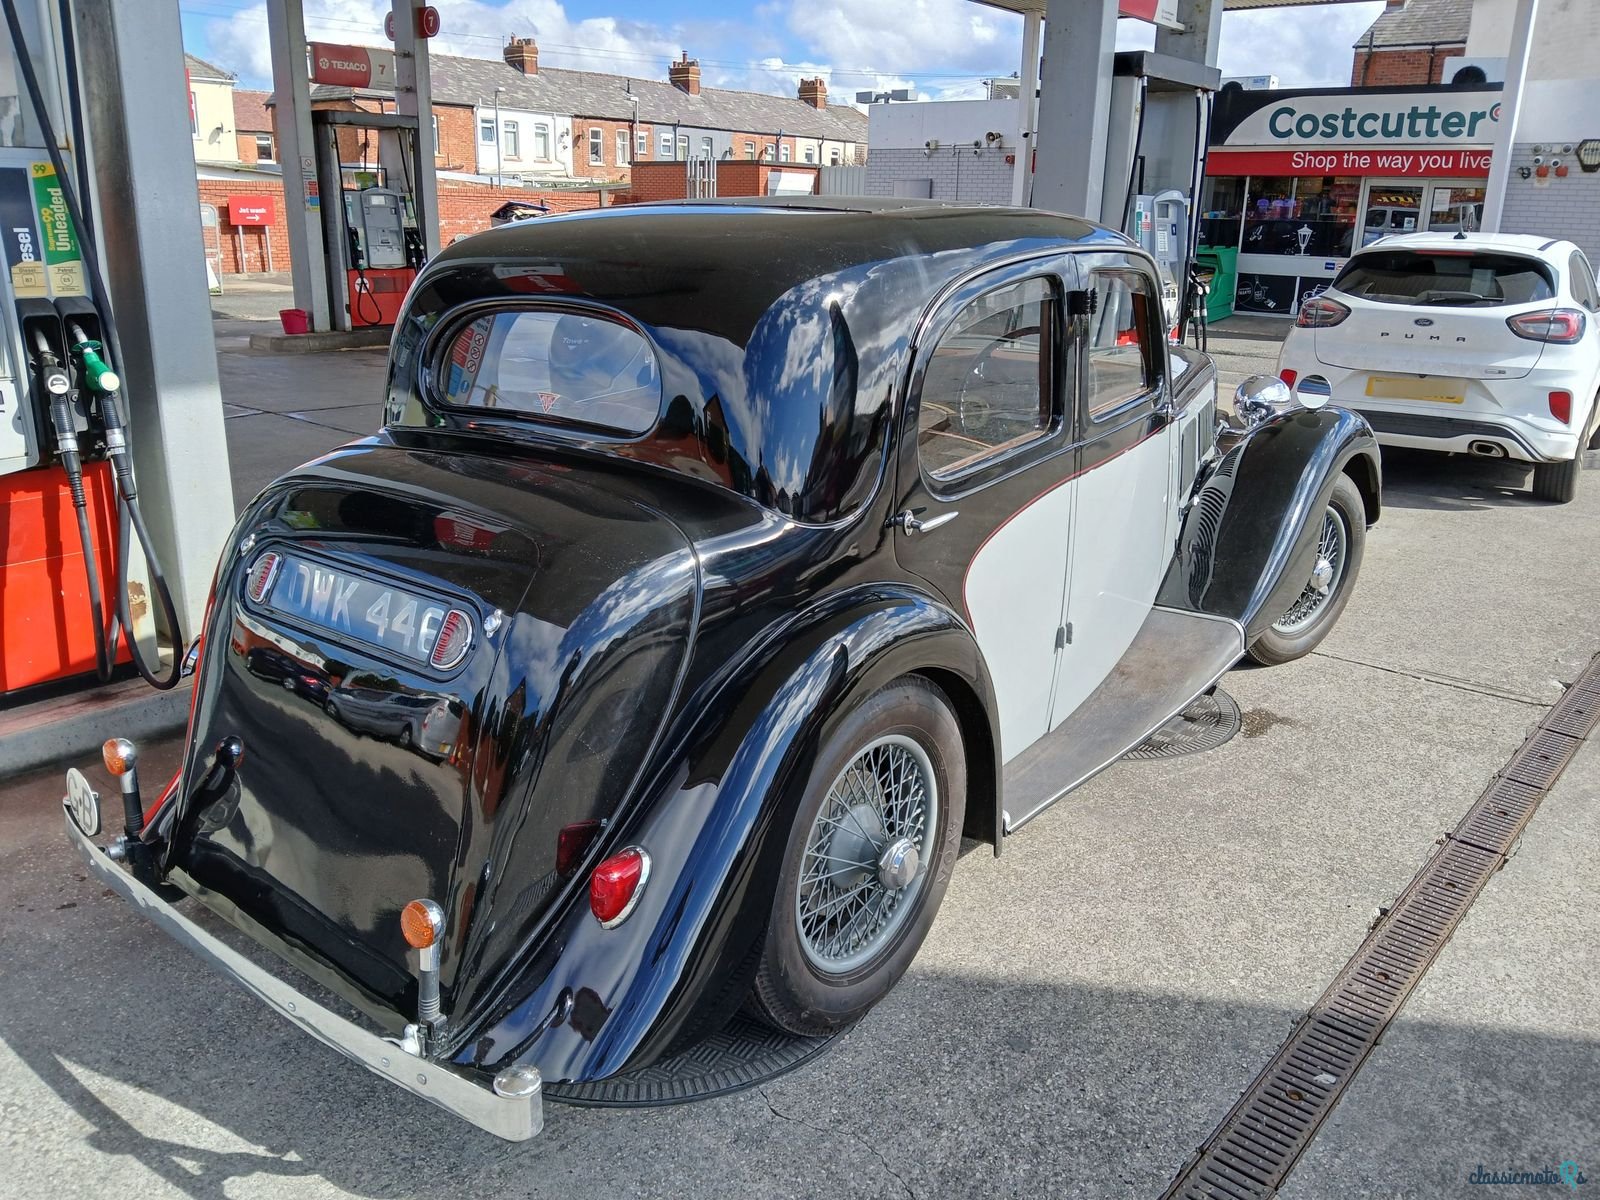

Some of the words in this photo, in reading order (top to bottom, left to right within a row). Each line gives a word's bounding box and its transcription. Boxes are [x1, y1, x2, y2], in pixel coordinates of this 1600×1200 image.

[428, 16, 434, 27] 7
[331, 60, 367, 72] TEXACO
[378, 64, 387, 75] 7
[1269, 105, 1487, 138] Costcutter
[33, 164, 47, 174] 99
[1292, 151, 1337, 172] Shop
[1343, 151, 1370, 168] the
[1377, 154, 1413, 172] way
[1419, 154, 1452, 172] you
[1459, 151, 1491, 169] live
[47, 187, 72, 252] Unleaded
[13, 227, 34, 262] esel
[287, 563, 360, 633] DWK
